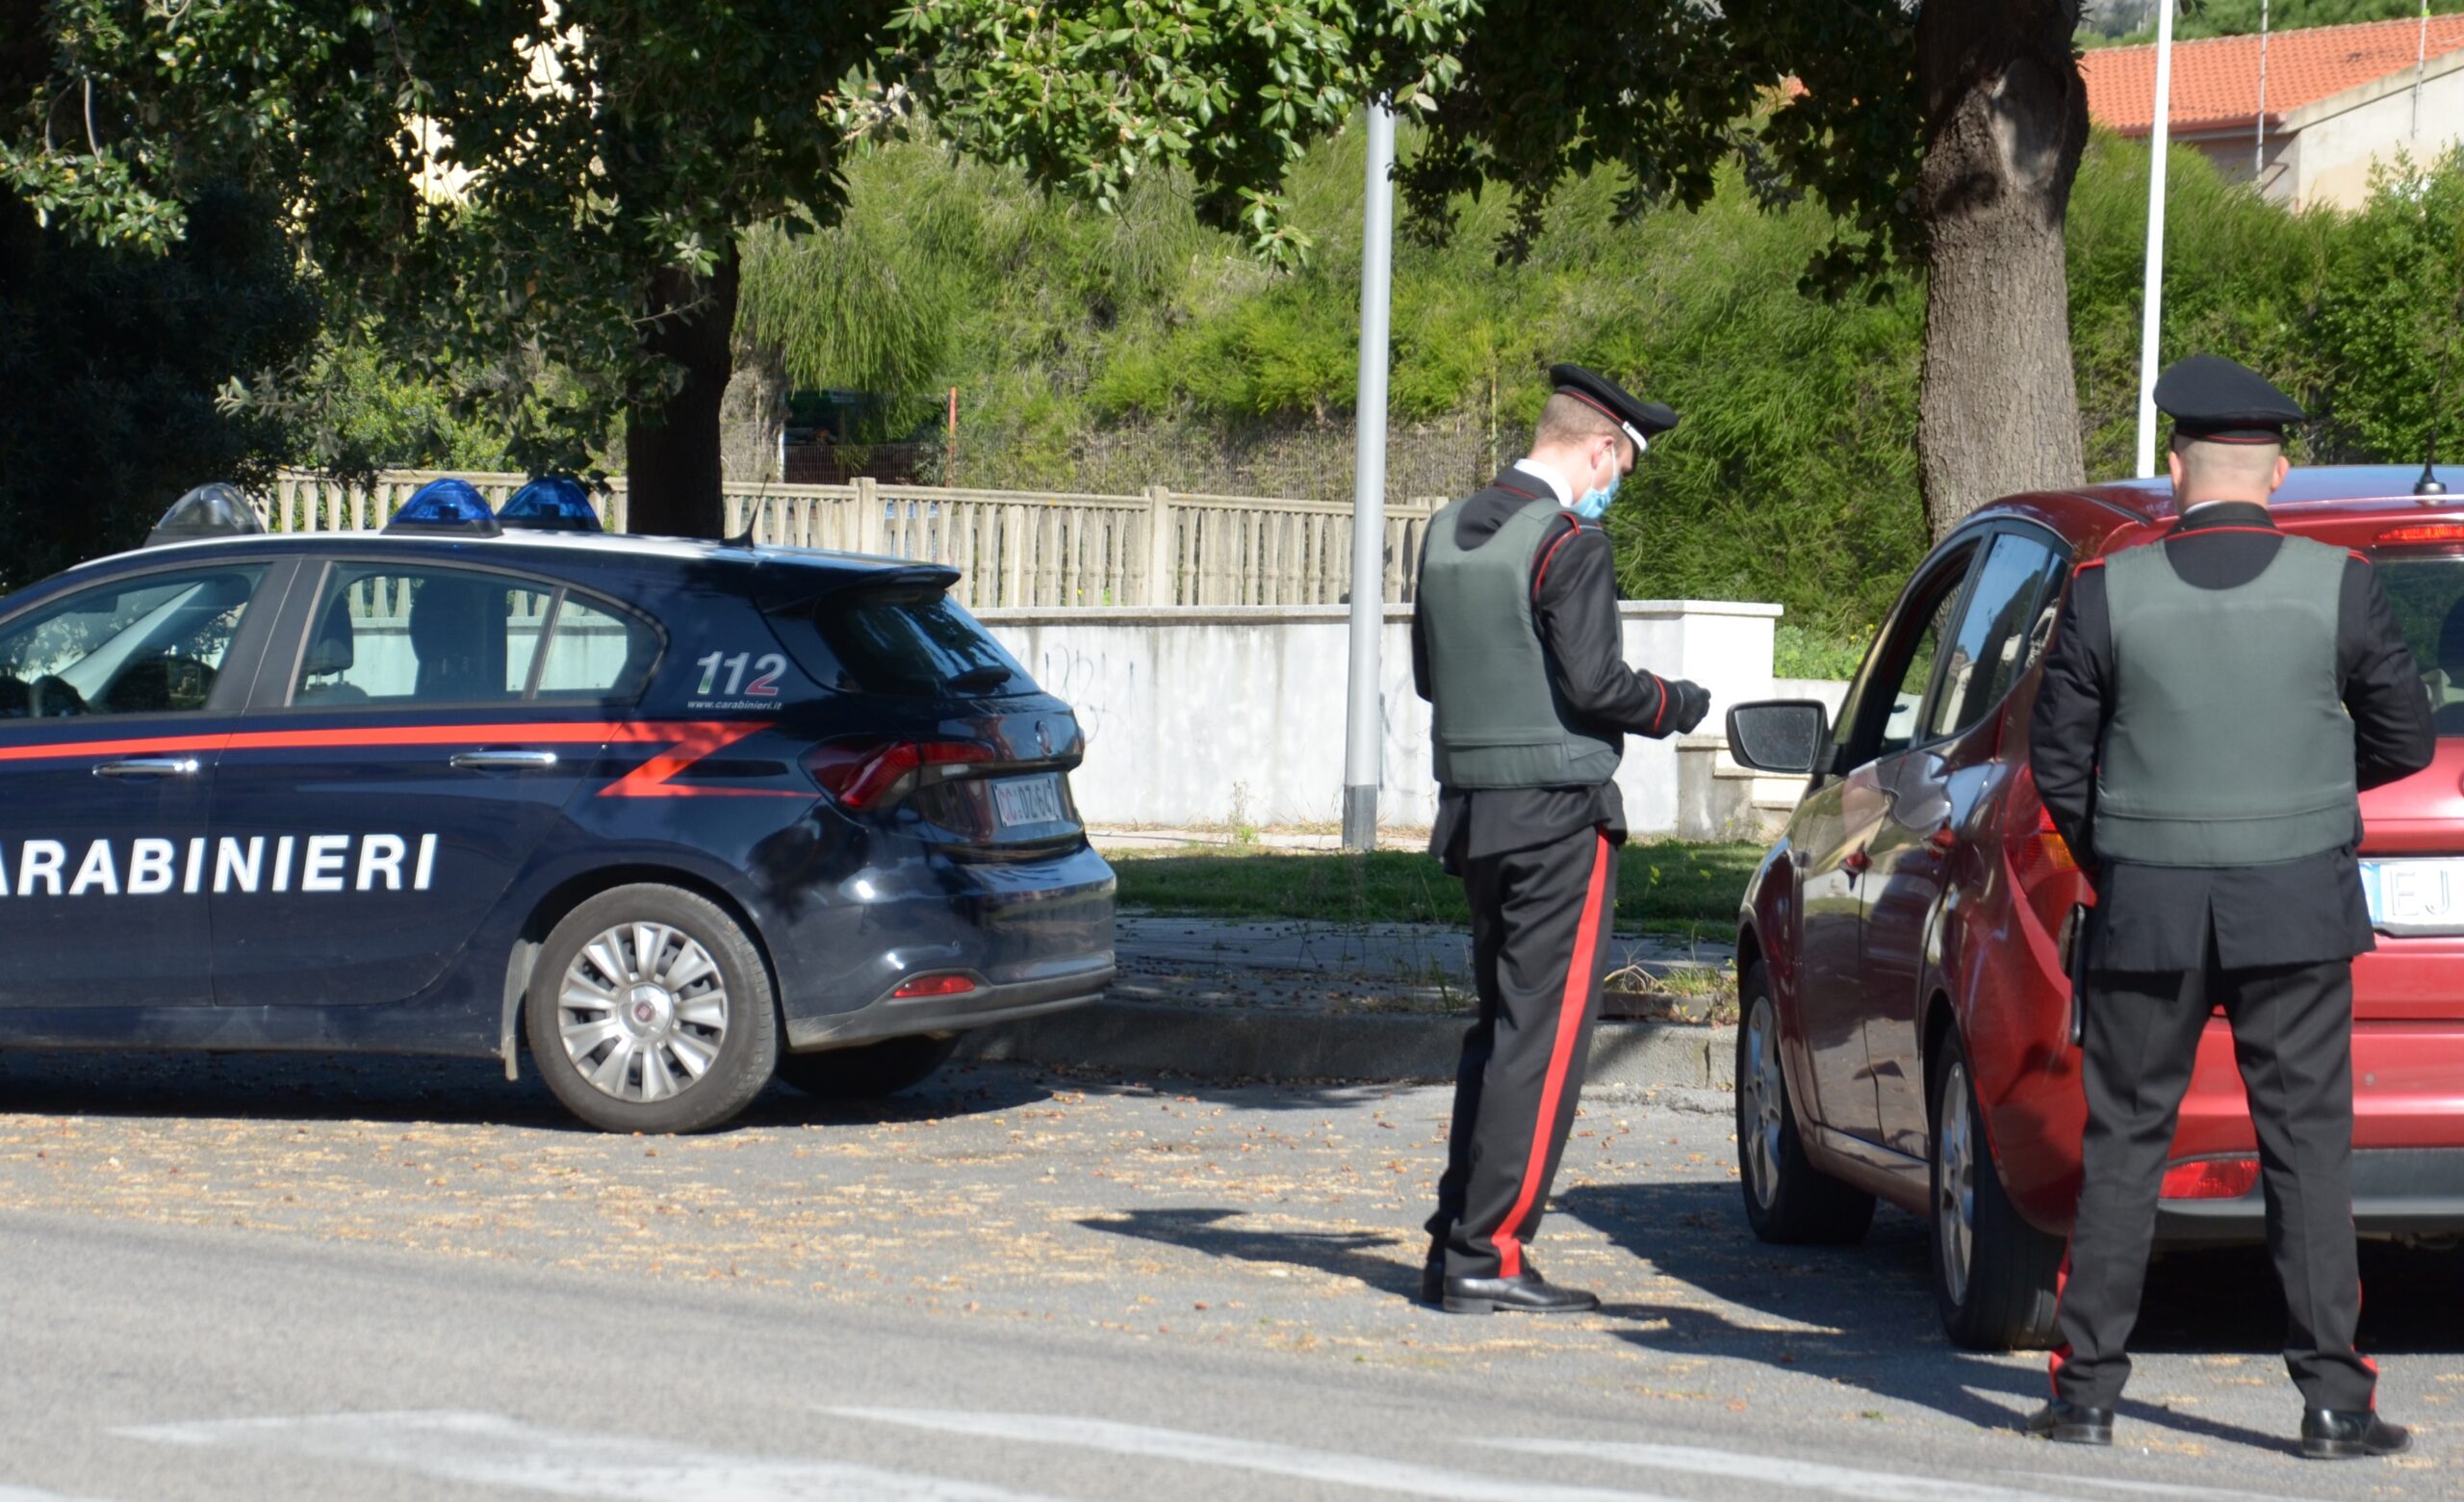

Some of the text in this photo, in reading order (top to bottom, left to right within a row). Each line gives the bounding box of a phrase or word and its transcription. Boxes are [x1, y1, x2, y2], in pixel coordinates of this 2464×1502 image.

[696, 651, 786, 696] 112
[687, 700, 782, 710] www.carabinieri.it
[0, 834, 437, 895] RABINIERI
